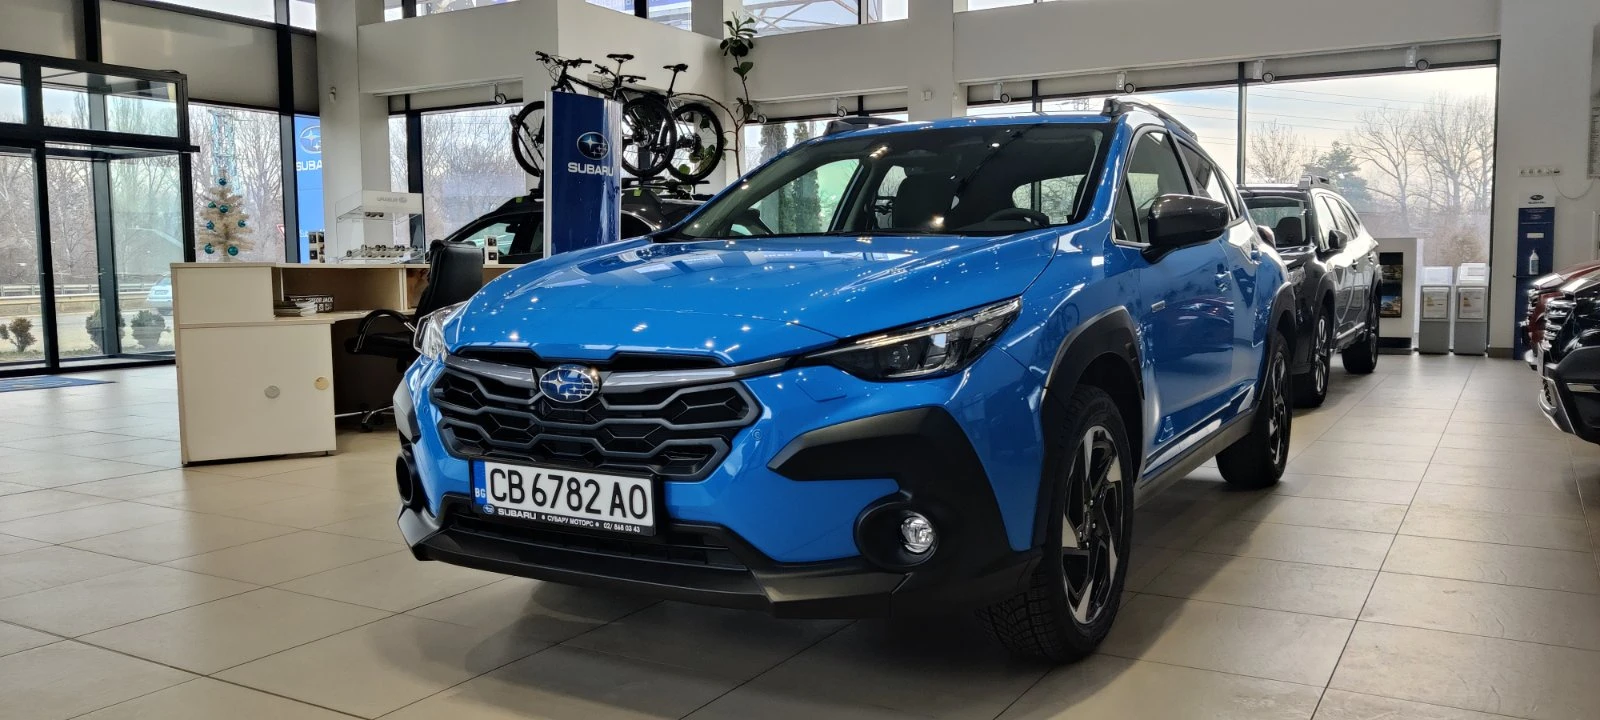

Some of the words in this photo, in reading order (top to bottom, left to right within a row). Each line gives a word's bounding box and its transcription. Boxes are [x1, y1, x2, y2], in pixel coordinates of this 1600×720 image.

[567, 161, 614, 177] SUBARU
[474, 487, 486, 499] BG
[532, 472, 602, 515] 6782
[497, 508, 537, 520] SUBARU
